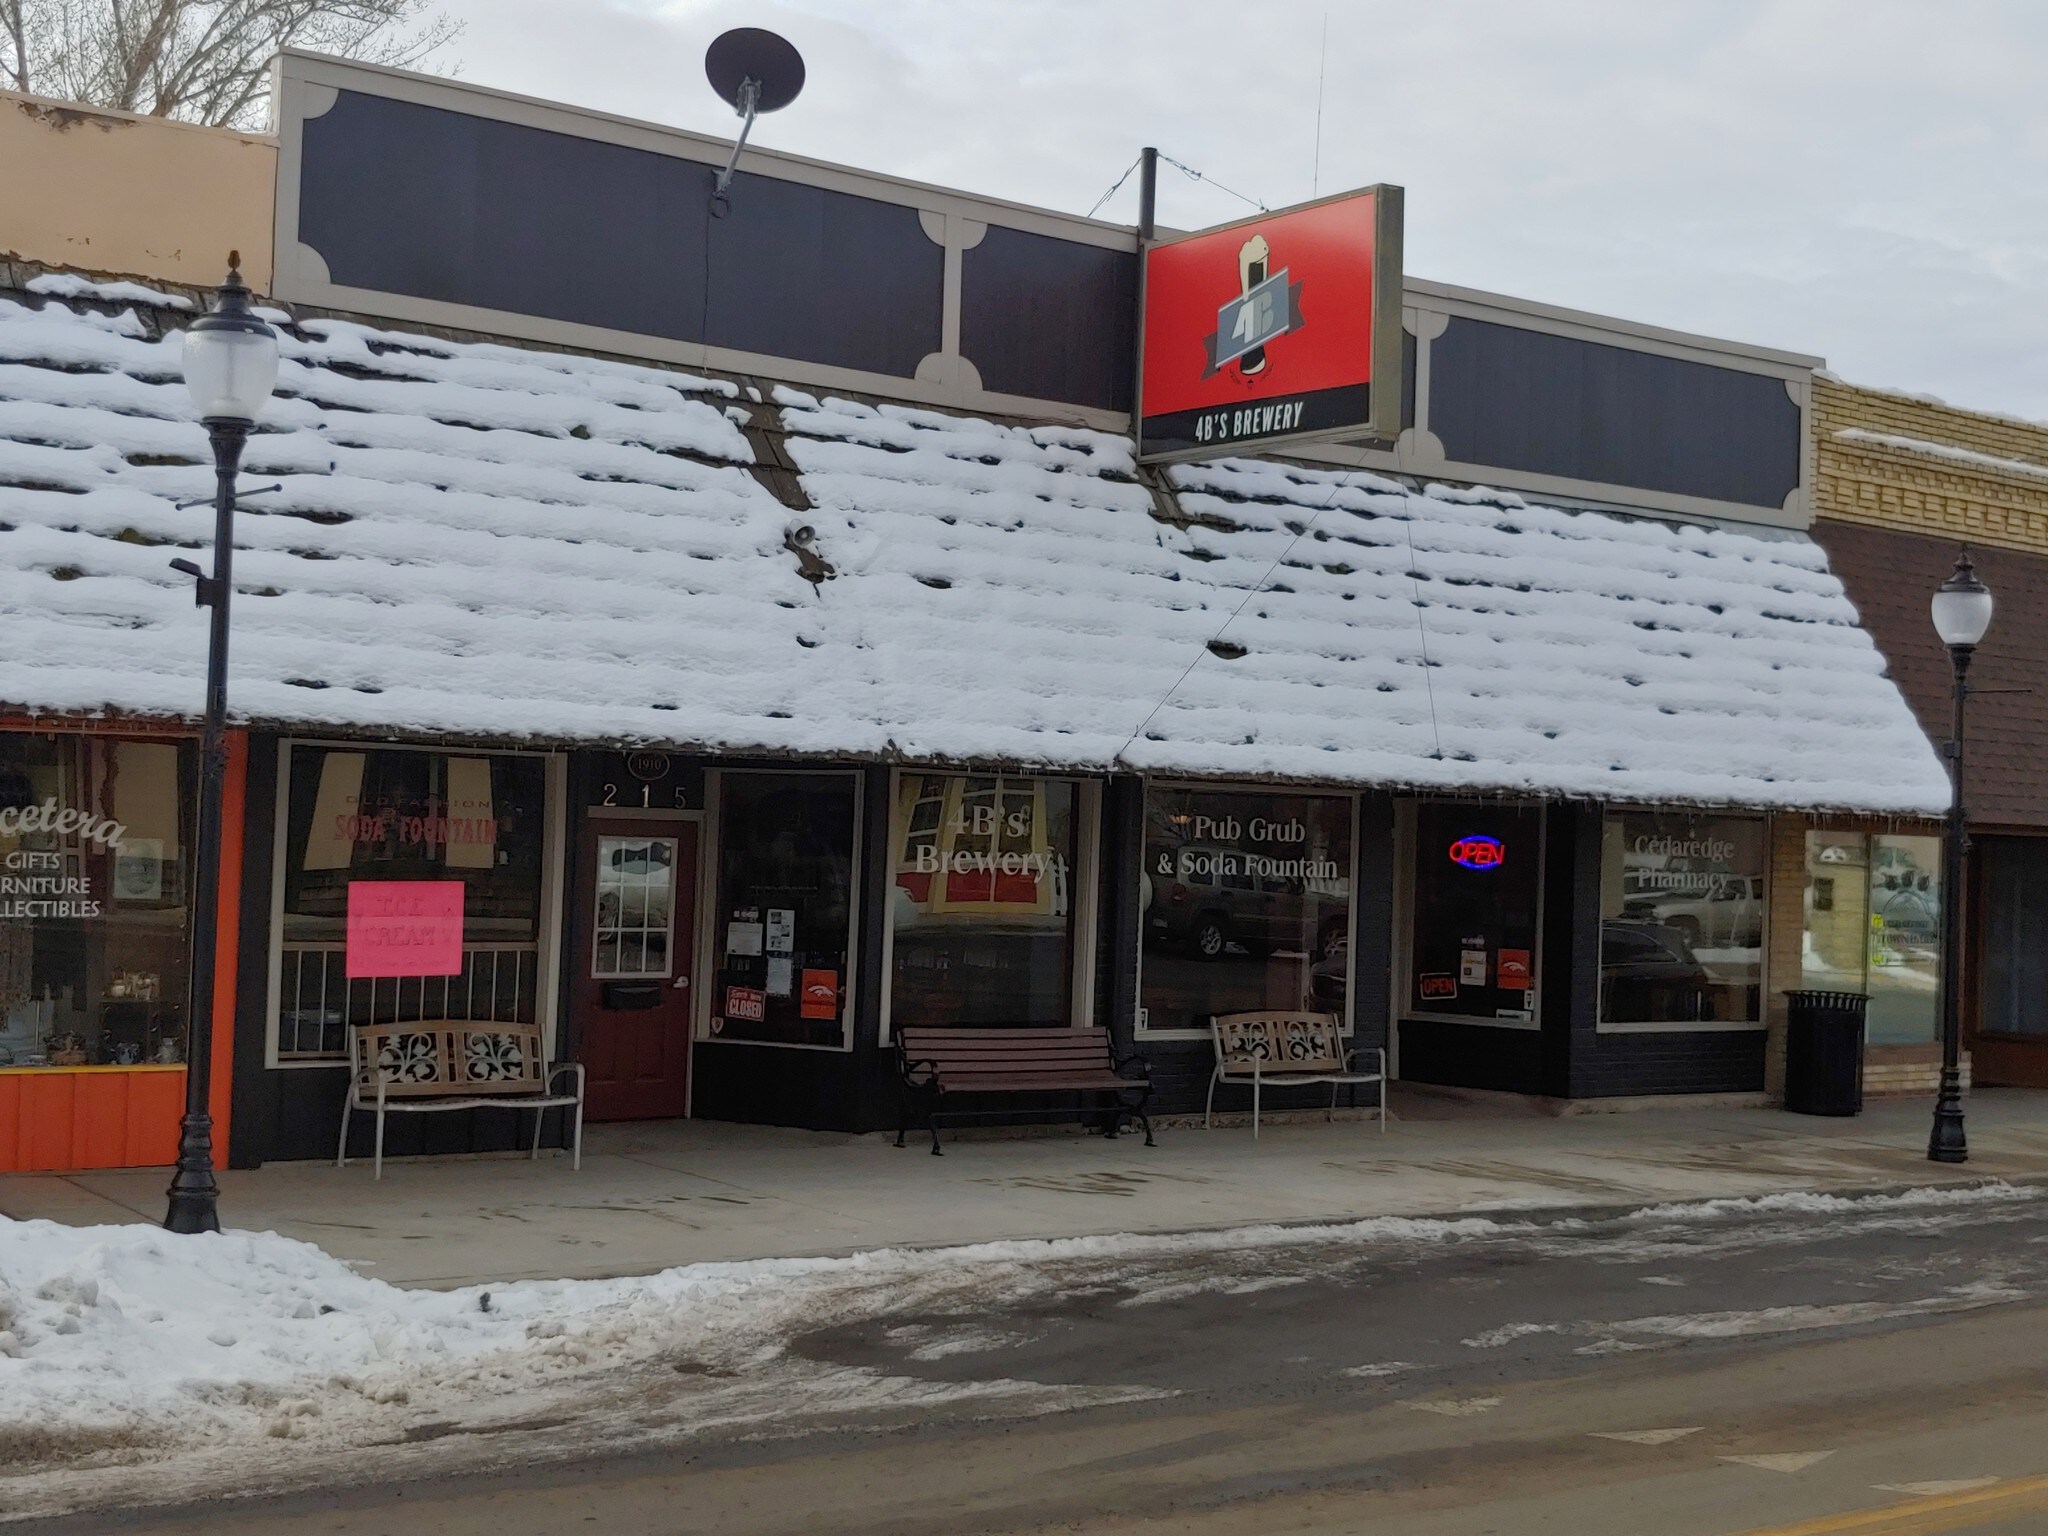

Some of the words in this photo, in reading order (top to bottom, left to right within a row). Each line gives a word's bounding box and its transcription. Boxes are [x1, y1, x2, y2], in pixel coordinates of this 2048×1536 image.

[1194, 411, 1229, 442] 4B'S
[1233, 401, 1304, 437] BREWERY
[335, 815, 386, 841] SODA
[399, 816, 497, 845] FOUNTAIN
[946, 804, 1025, 838] 4B's
[1193, 815, 1242, 841] Pub
[1249, 818, 1306, 843] Grub
[5, 852, 62, 870] GIFTS
[1449, 841, 1505, 865] OPEN
[1634, 835, 1736, 862] Cedaredge
[916, 845, 1052, 884] Brewery
[1157, 853, 1174, 875] &
[1180, 852, 1237, 876] Soda
[1244, 855, 1338, 879] Fountain
[1, 877, 92, 895] RNITURE
[1637, 868, 1730, 893] Pharmacy
[1423, 977, 1453, 995] OPEN
[729, 998, 763, 1018] CLOSED
